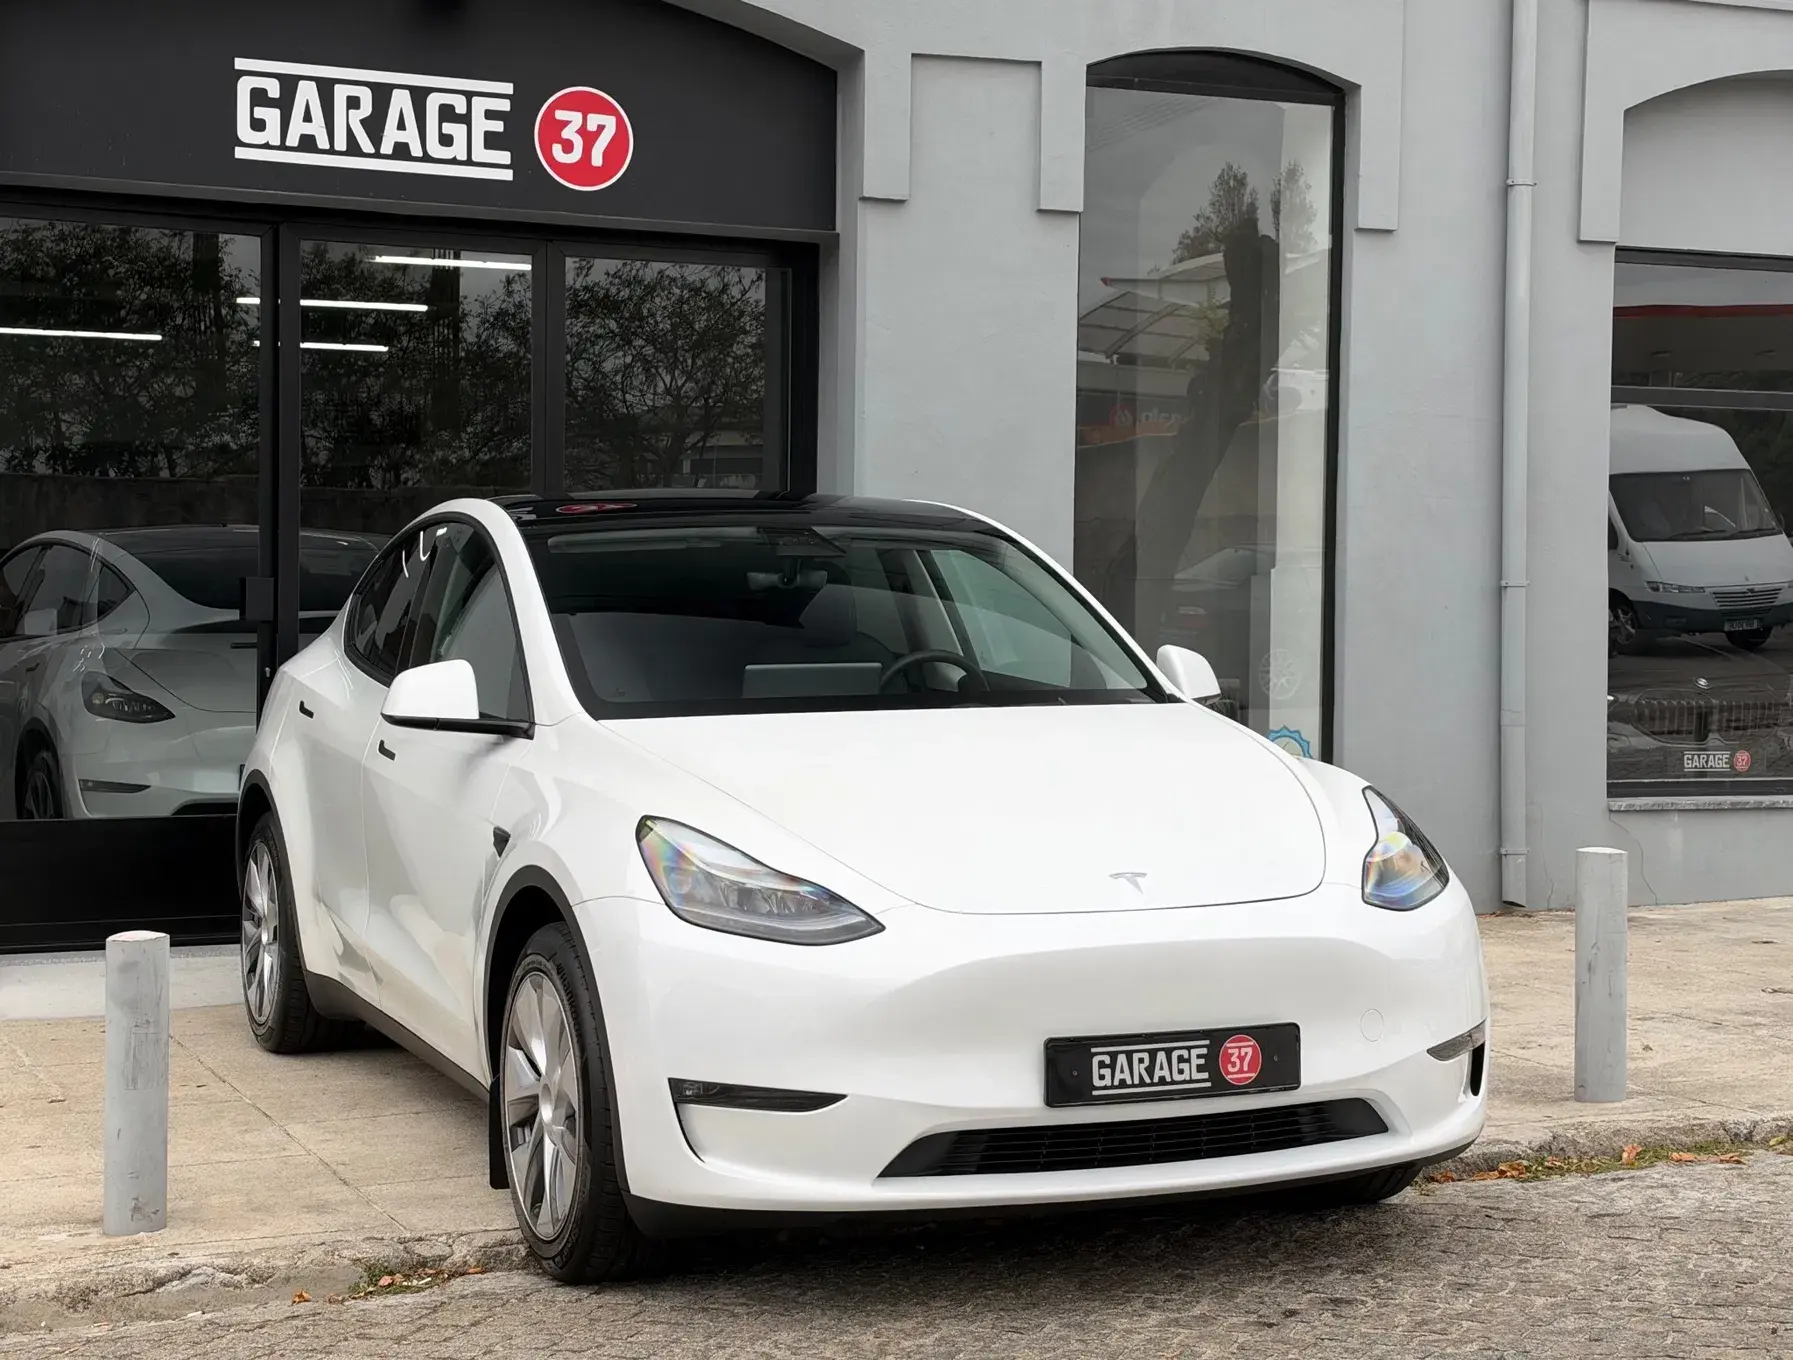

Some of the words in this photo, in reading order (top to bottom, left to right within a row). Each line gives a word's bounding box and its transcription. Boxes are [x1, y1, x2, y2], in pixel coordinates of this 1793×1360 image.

[236, 75, 512, 165] GARAGE
[551, 109, 617, 167] 37
[1683, 754, 1731, 769] GARAGE
[1736, 755, 1748, 766] 37
[1092, 1047, 1210, 1087] GARAGE
[1227, 1046, 1253, 1073] 37
